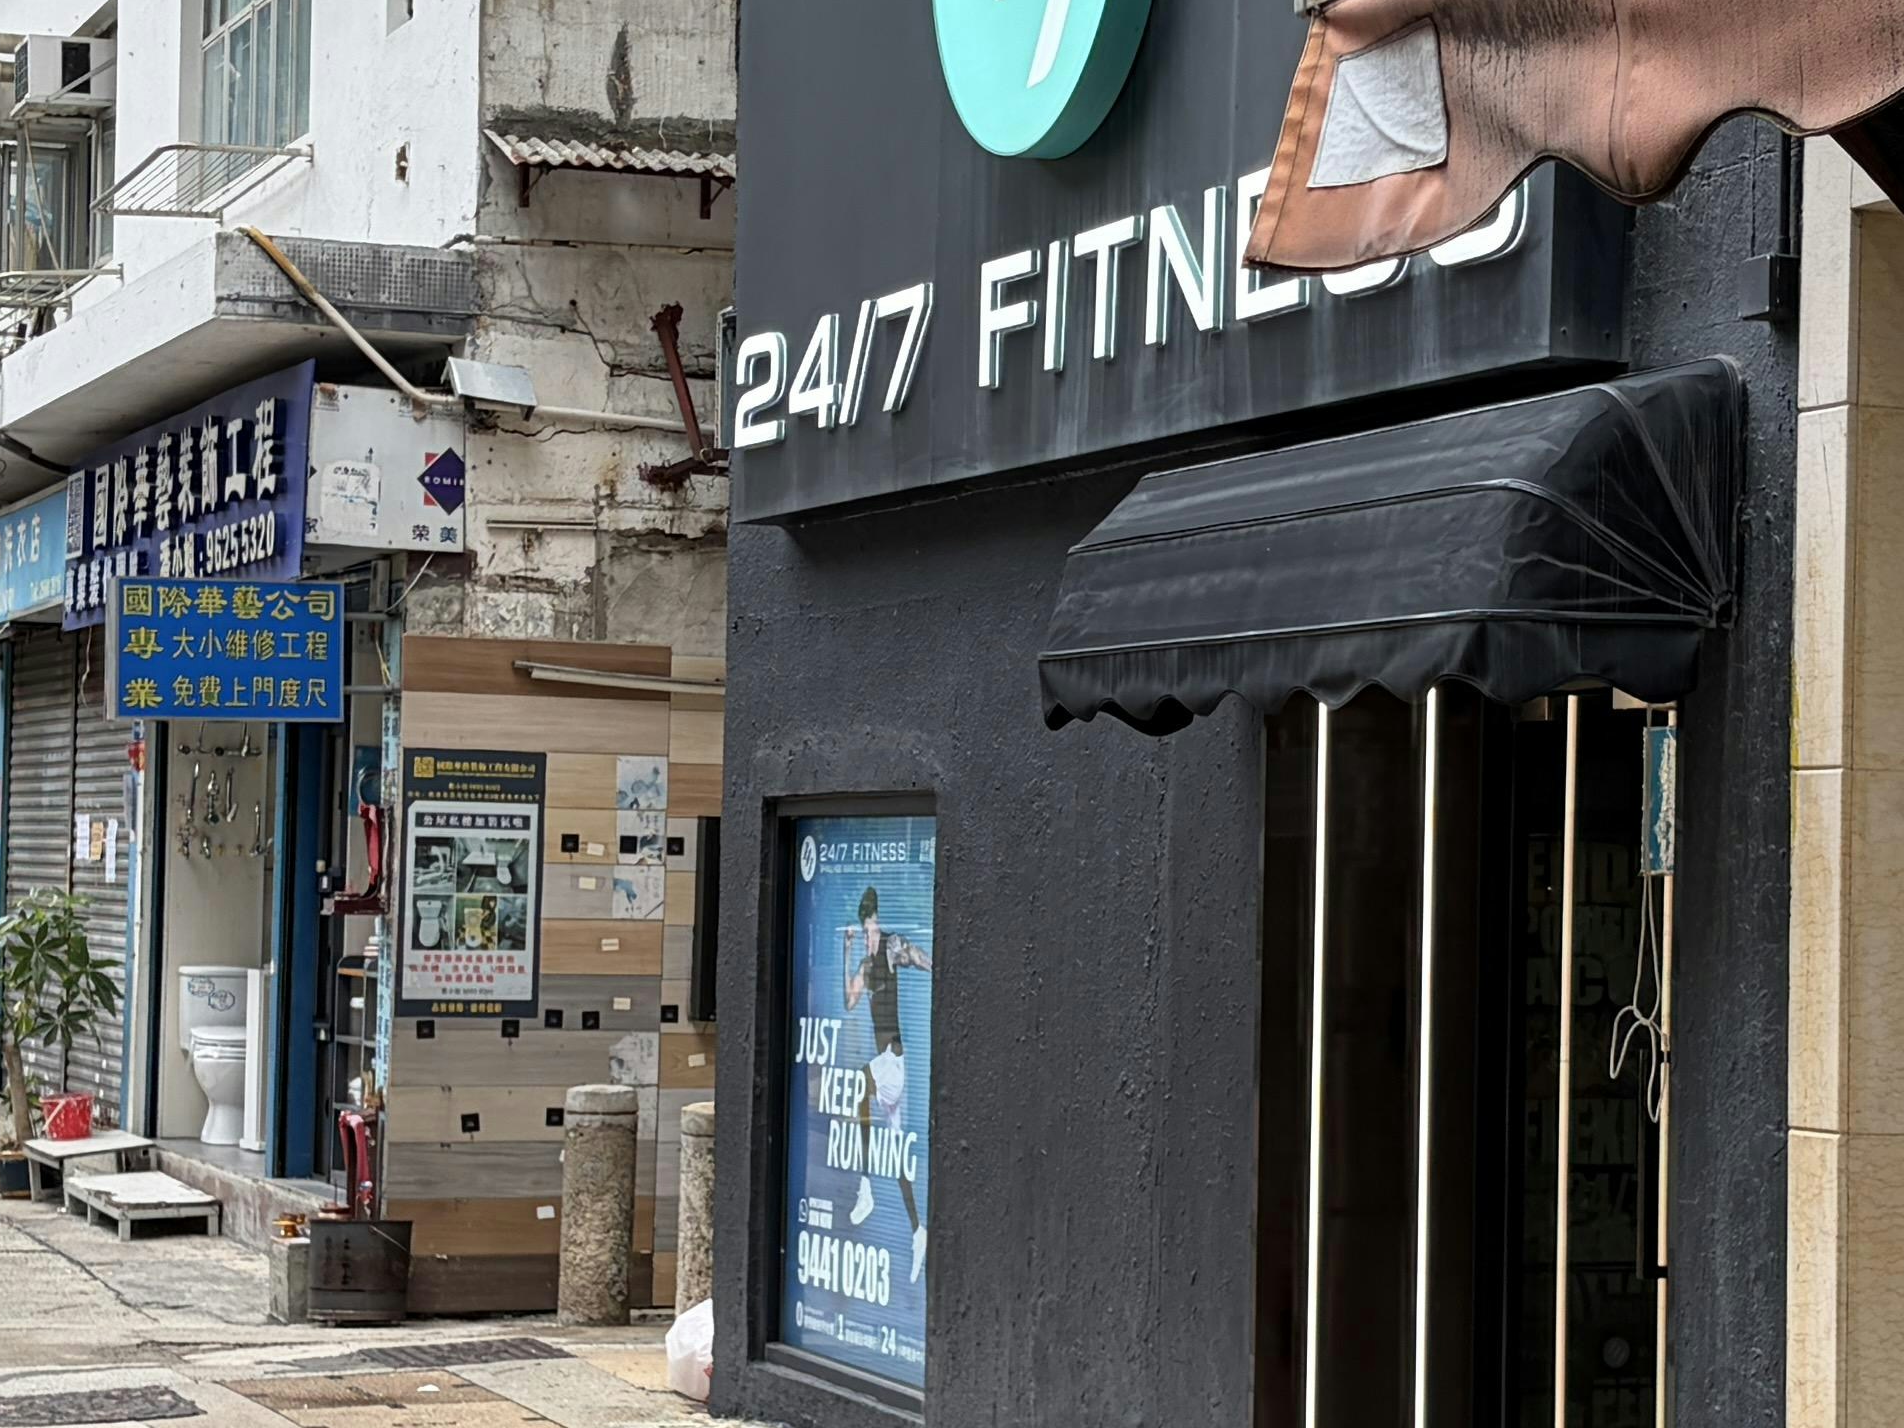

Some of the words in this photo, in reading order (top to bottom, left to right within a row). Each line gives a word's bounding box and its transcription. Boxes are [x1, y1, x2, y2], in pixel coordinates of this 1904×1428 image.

[733, 281, 936, 450] 24/7
[978, 167, 1532, 390] FITNE
[122, 584, 335, 621] 國際華藝公司
[172, 627, 328, 661] 大小維修工程
[172, 673, 328, 708] 免費上門度尺
[819, 843, 848, 862] 24/7
[853, 841, 907, 863] FITNESS
[795, 1017, 842, 1066] JUST
[819, 1066, 866, 1118] KEEP
[827, 1119, 918, 1182] RUNNING
